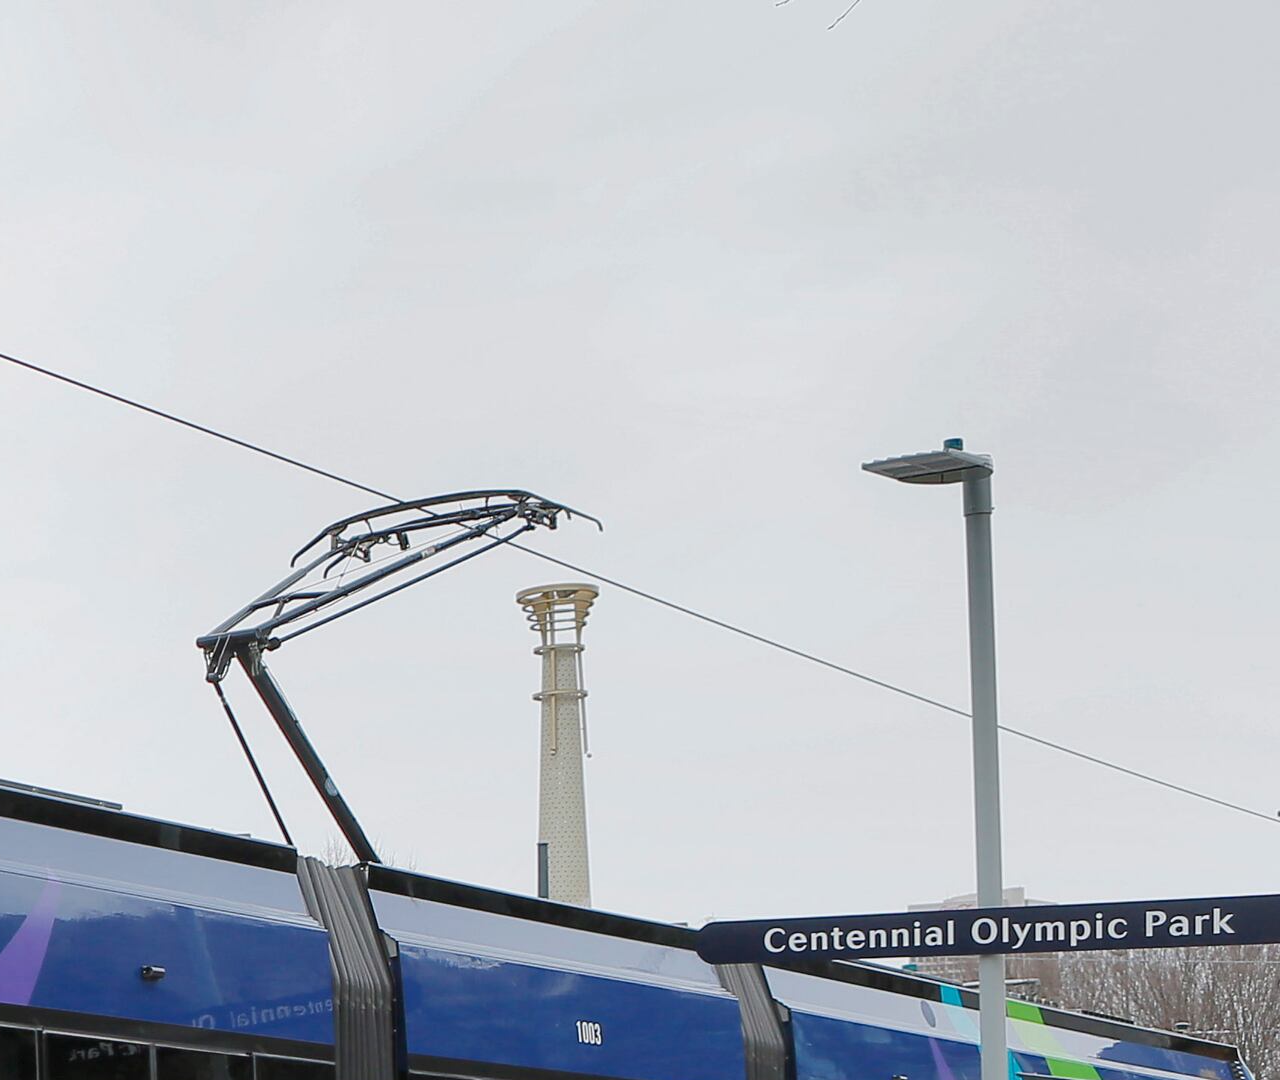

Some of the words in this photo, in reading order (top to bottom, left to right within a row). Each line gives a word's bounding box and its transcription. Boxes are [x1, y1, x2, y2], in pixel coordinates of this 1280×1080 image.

[763, 921, 955, 953] Centennial
[971, 912, 1128, 950] Olympic
[1144, 907, 1236, 938] Park
[575, 1020, 602, 1046] 1003
